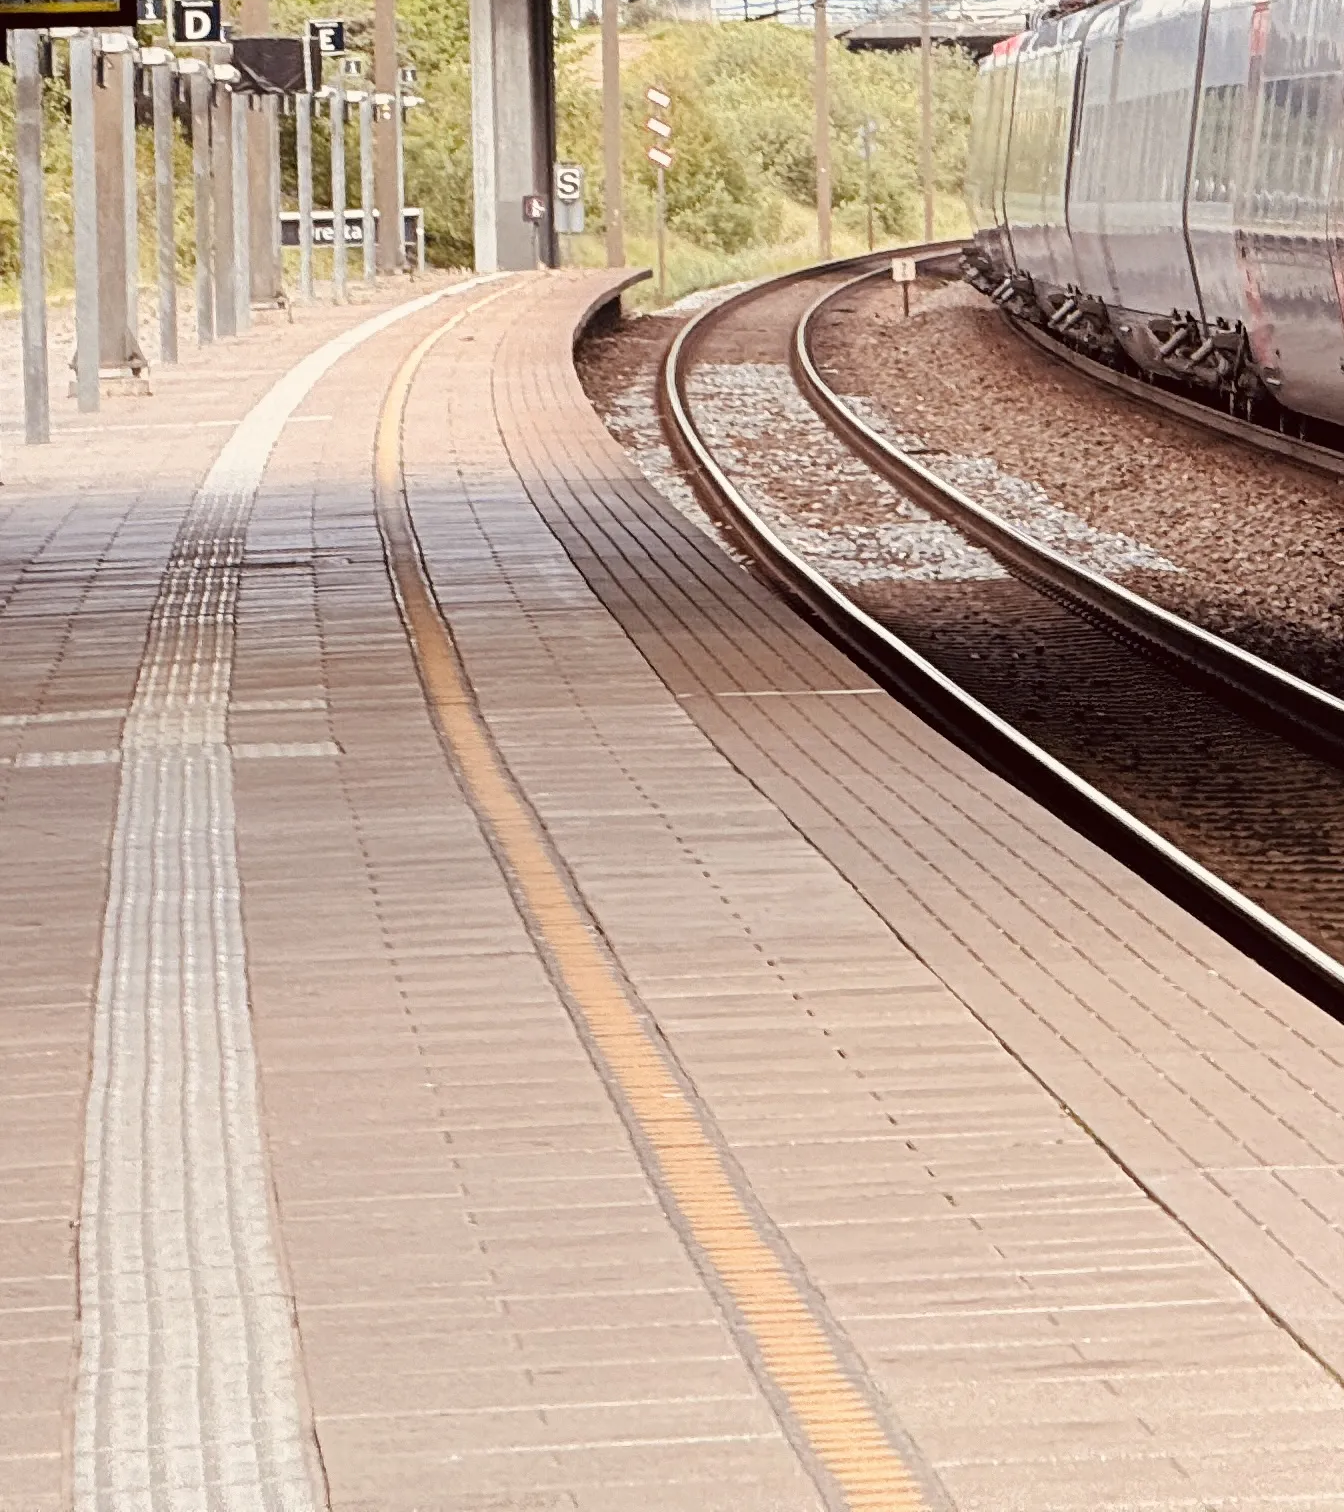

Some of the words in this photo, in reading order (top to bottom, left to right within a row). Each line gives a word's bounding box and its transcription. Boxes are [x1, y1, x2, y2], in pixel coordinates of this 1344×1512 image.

[184, 10, 212, 40] D
[319, 28, 336, 51] E
[559, 171, 579, 196] S
